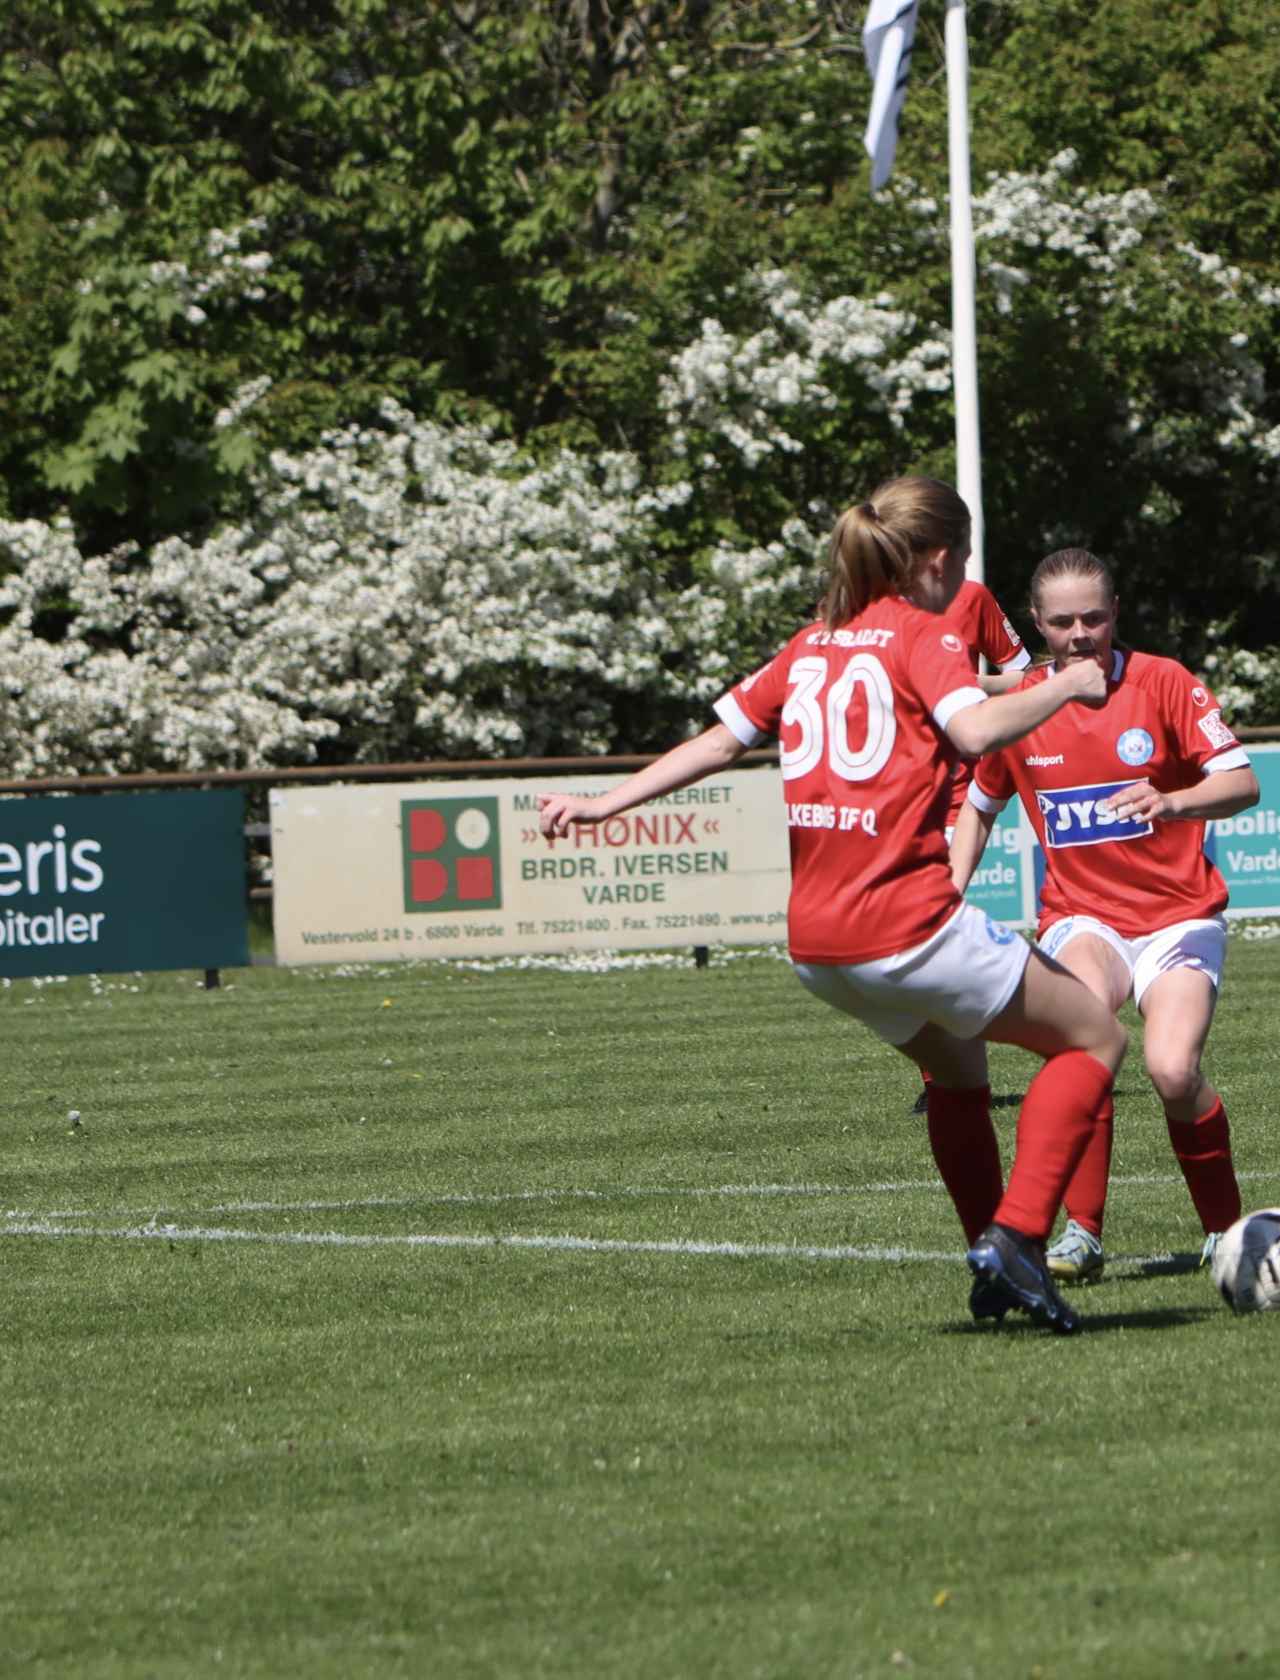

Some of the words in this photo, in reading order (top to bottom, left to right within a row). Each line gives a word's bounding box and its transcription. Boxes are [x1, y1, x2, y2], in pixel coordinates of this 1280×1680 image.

[779, 653, 896, 781] 30
[862, 808, 879, 837] Q
[521, 857, 605, 880] BRDR.
[614, 851, 729, 877] IVERSEN
[968, 861, 1017, 886] arde
[582, 883, 666, 904] VARDE
[464, 923, 504, 937] Varde
